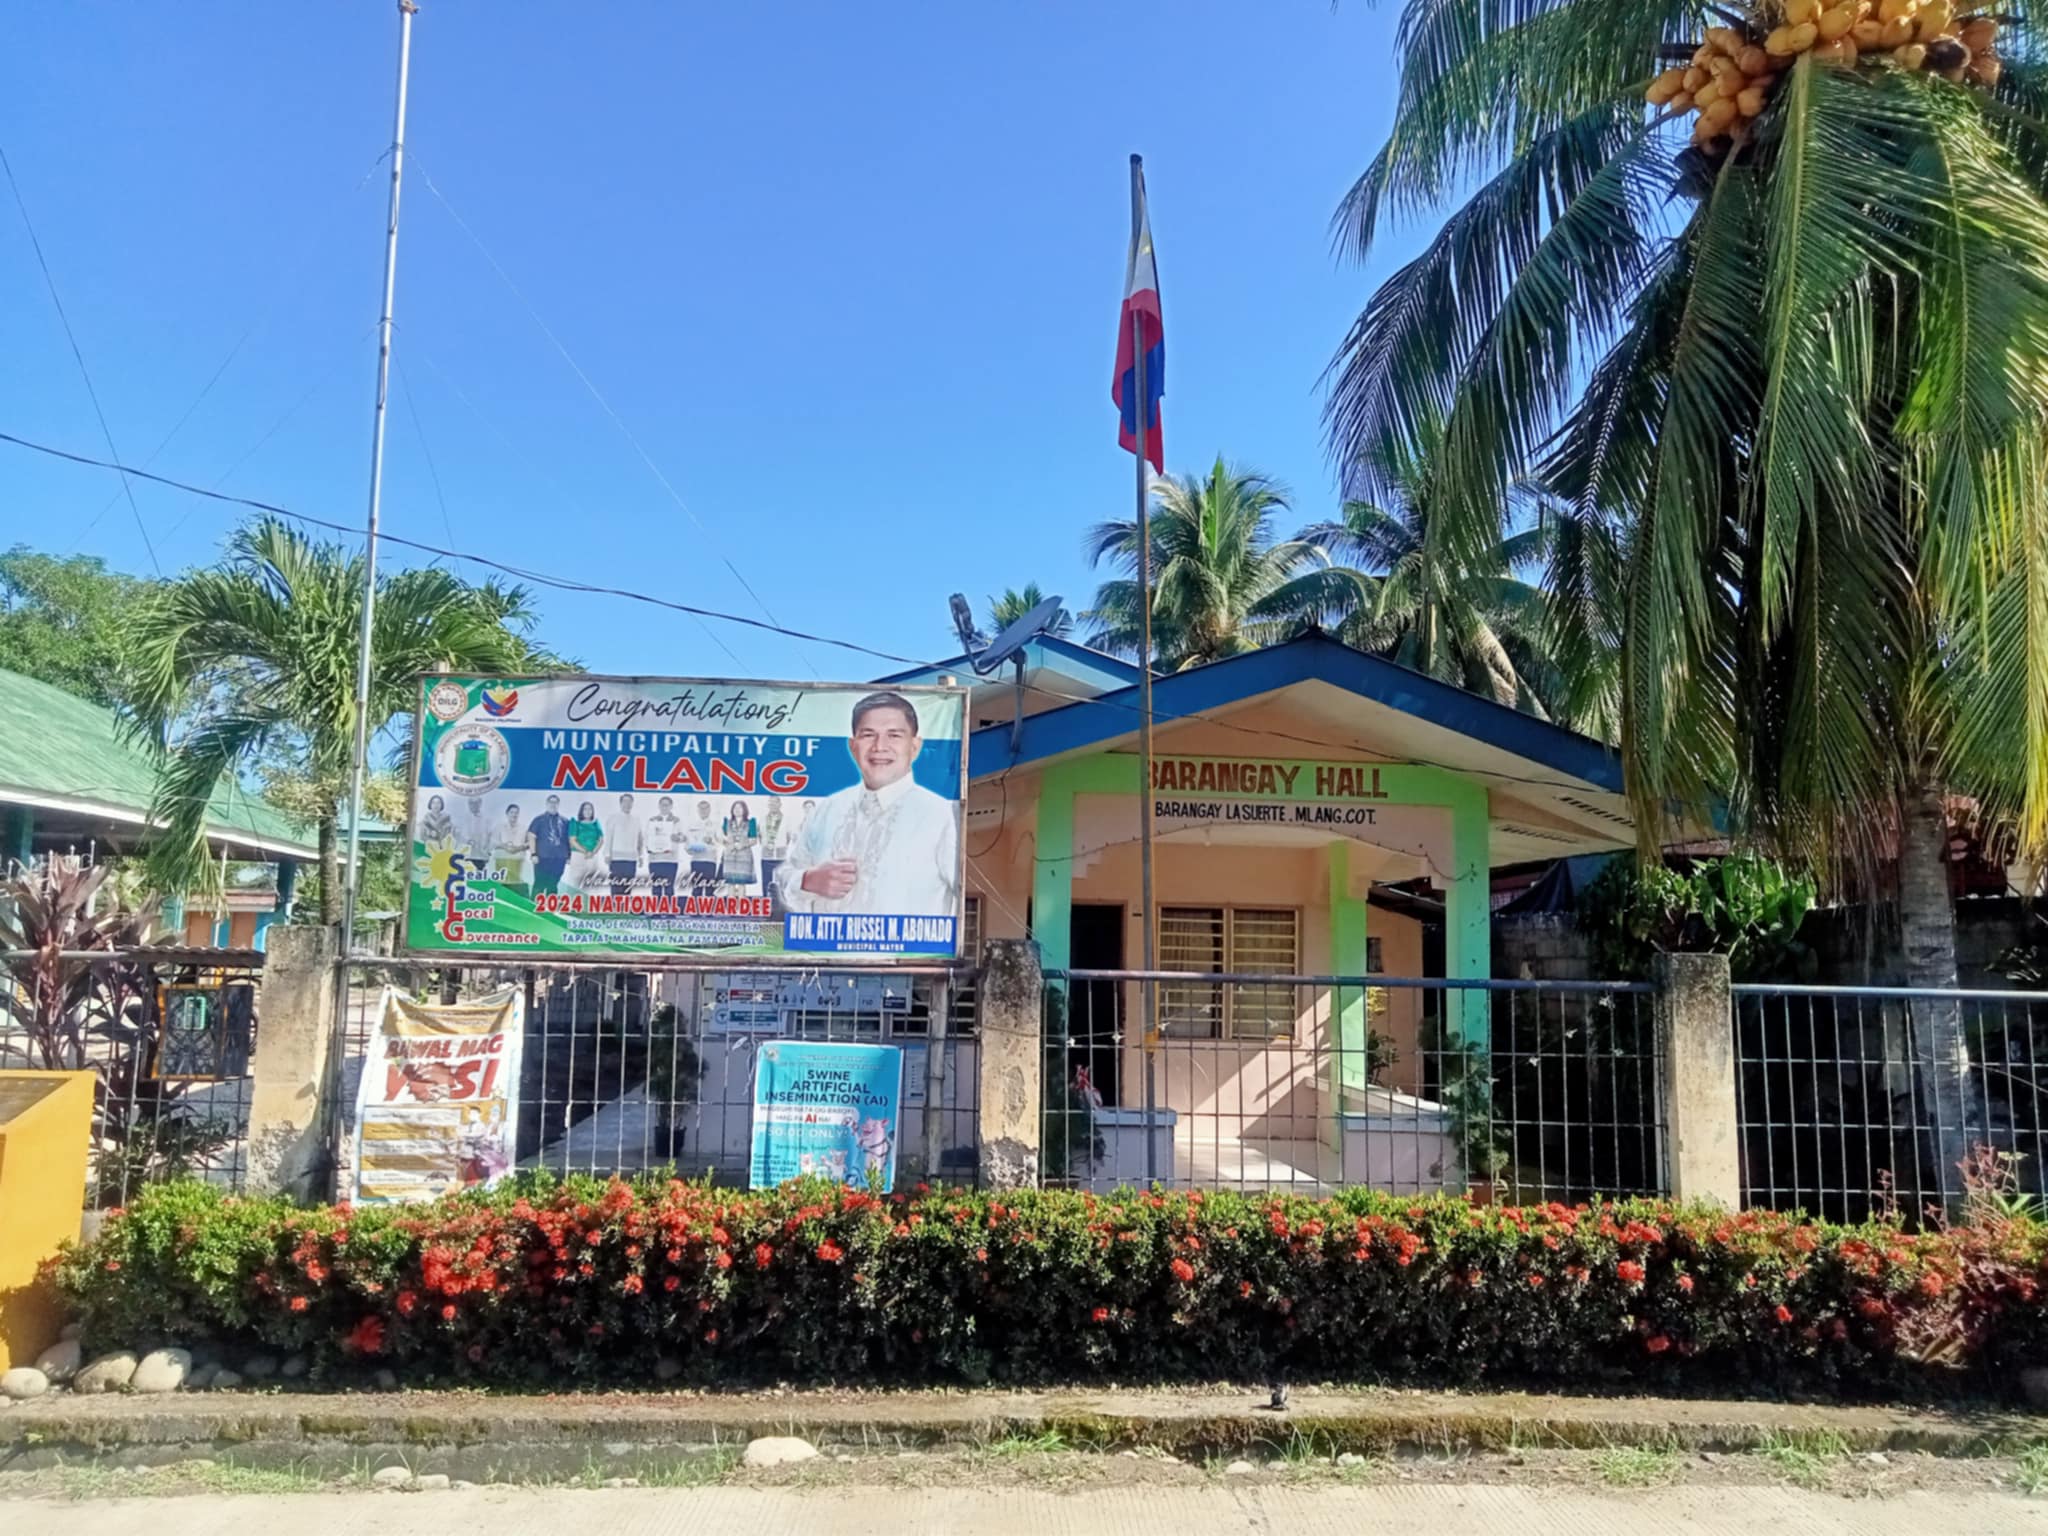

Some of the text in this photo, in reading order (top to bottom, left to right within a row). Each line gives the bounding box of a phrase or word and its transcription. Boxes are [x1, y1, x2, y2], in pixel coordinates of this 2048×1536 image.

[567, 682, 804, 731] Congratulations!
[543, 730, 822, 757] MUNICIPALITY OF
[551, 753, 810, 794] M'LANG
[1316, 766, 1388, 799] HALL
[1155, 801, 1223, 819] BARANGAY
[491, 868, 507, 880] of
[447, 892, 493, 920] Local
[535, 893, 771, 917] 2024 NATIONAL AWARDEE
[442, 917, 539, 943] Governance
[569, 919, 602, 930] ISANG
[606, 919, 648, 931] DEKADA
[652, 920, 667, 931] NA
[789, 915, 815, 940] HON.
[816, 916, 844, 941] ATTY.
[902, 917, 953, 943] ABONADO
[563, 933, 765, 945] TAPAT AT MAHUSAY NA PAMAMAHALA
[836, 943, 905, 952] MUNICIPAL MAYOR
[384, 1033, 504, 1059] BAWAL MAG
[383, 1058, 500, 1103] YSI
[807, 1069, 851, 1081] SWINE
[765, 1091, 889, 1107] INSEMINATION (AI)
[791, 1081, 871, 1094] ARTIFICIAL
[805, 1113, 817, 1123] AI
